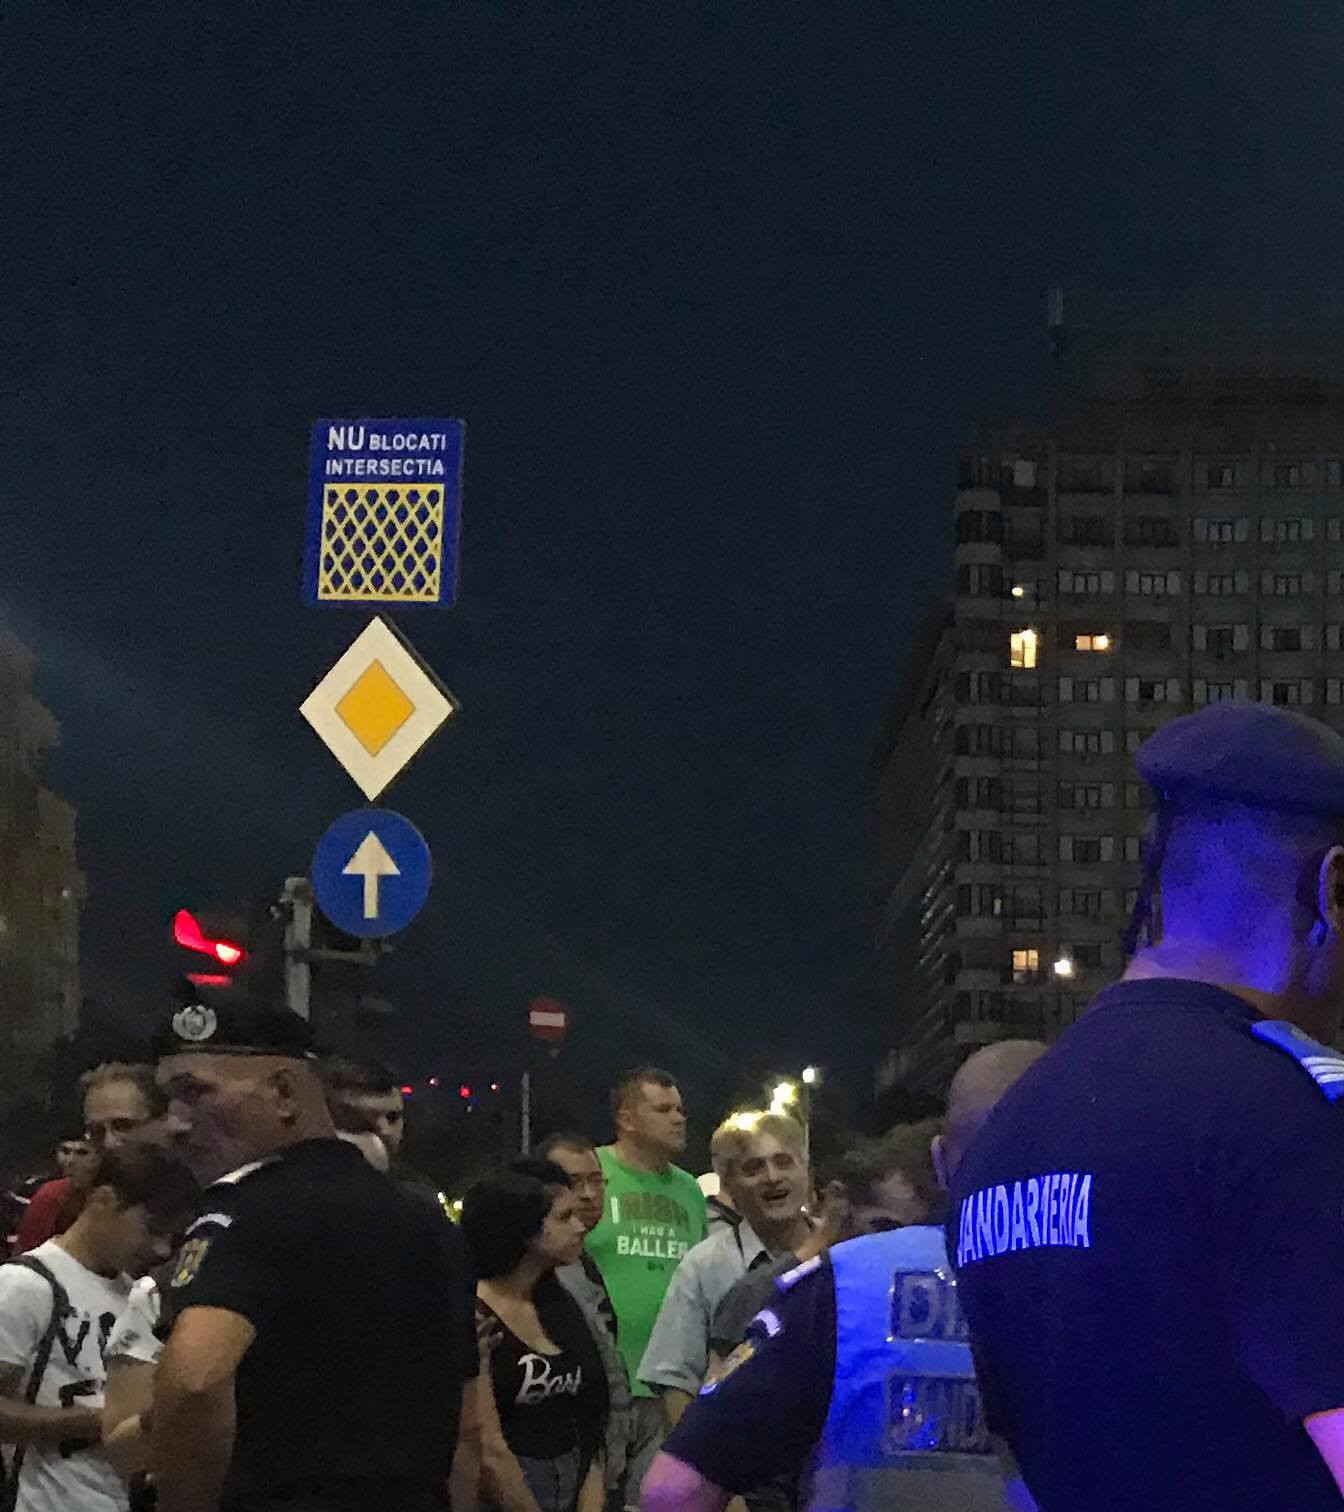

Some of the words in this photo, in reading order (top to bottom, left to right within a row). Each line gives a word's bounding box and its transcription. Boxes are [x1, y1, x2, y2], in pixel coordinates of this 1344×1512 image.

[327, 425, 365, 451] NU
[368, 433, 446, 451] BLOCATI
[325, 458, 444, 476] INTERSECTIA
